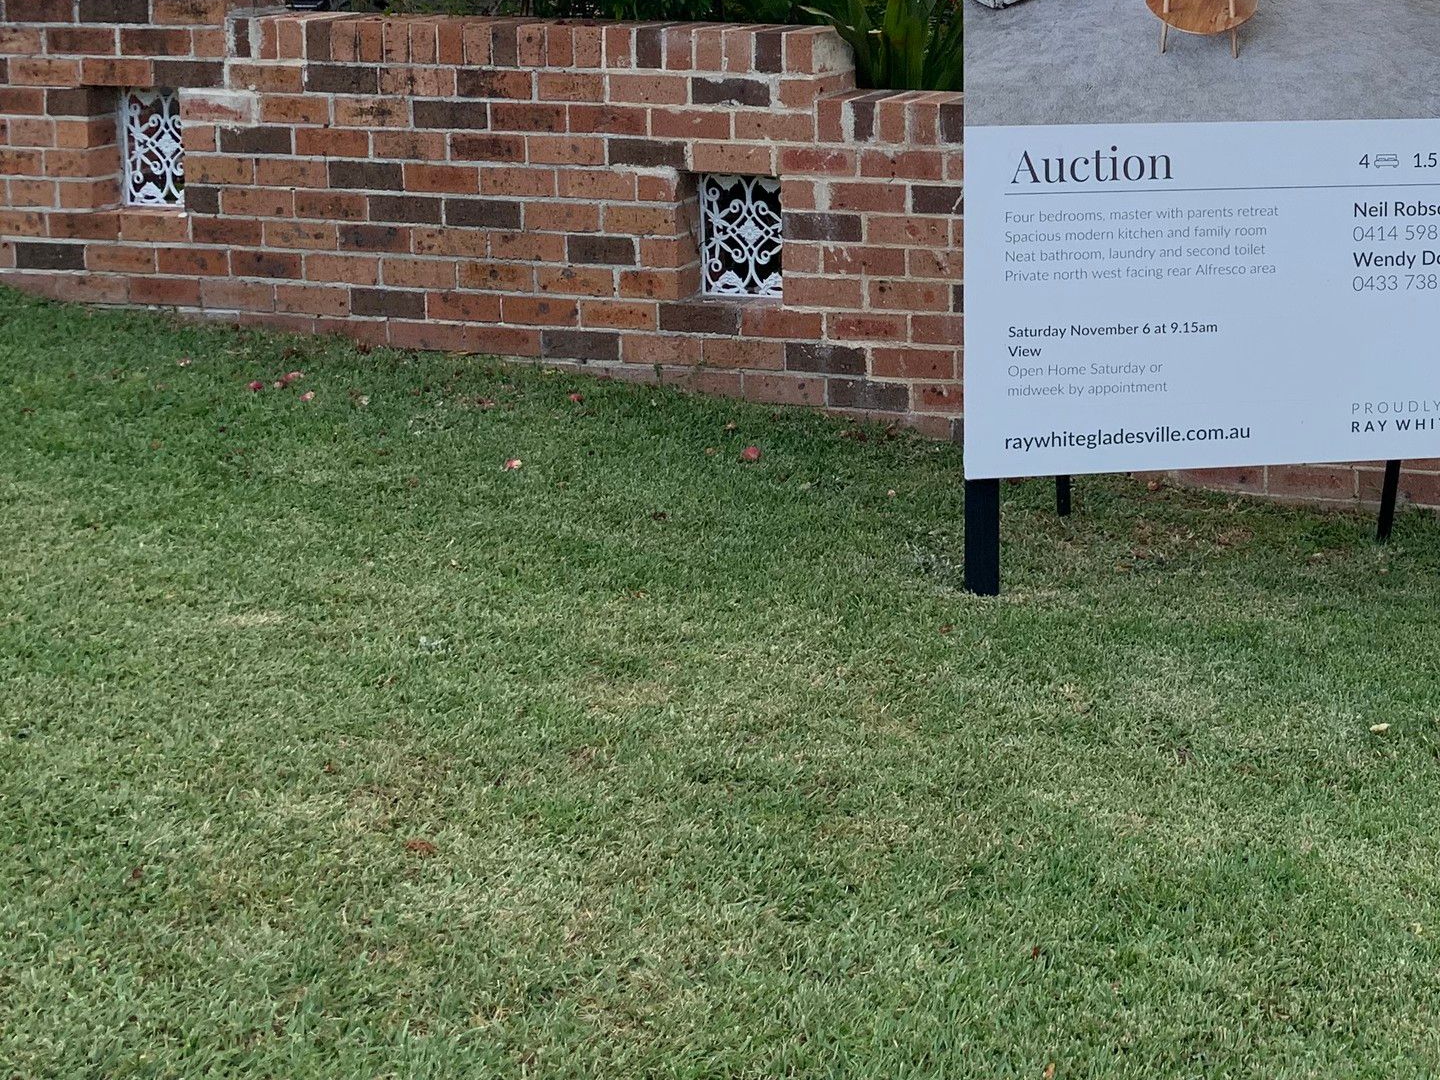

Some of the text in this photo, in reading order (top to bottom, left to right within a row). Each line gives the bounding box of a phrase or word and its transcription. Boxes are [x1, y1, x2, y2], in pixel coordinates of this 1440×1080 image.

[1010, 145, 1174, 185] Auction
[1358, 153, 1371, 169] 4
[1413, 152, 1438, 168] 1.5
[1005, 211, 1036, 224] Four
[1109, 208, 1153, 221] master
[1155, 206, 1184, 220] with
[1187, 206, 1234, 221] parents
[1237, 205, 1279, 217] retreat
[1353, 201, 1388, 218] Neil
[1004, 224, 1267, 246] Spacious modern kitchen and family room
[1352, 225, 1399, 242] 0414
[1404, 223, 1438, 241] 598
[1005, 250, 1037, 263] Neat
[1108, 246, 1157, 260] laundry
[1159, 245, 1183, 258] and
[1186, 244, 1231, 257] second
[1234, 243, 1266, 256] toilet
[1352, 250, 1417, 270] Wendy
[1005, 263, 1277, 282] Private north west facing rear Alfresco area
[1352, 274, 1399, 292] 0433
[1403, 273, 1438, 290] 738
[1008, 321, 1218, 340] Saturday November 6 at 9.15am
[1007, 345, 1042, 357] View
[1007, 361, 1164, 380] Open Home Saturday or
[1007, 381, 1168, 397] midweek by appointment
[1351, 419, 1388, 433] RAY
[1005, 425, 1250, 453] raywhitegladesville.com.au
